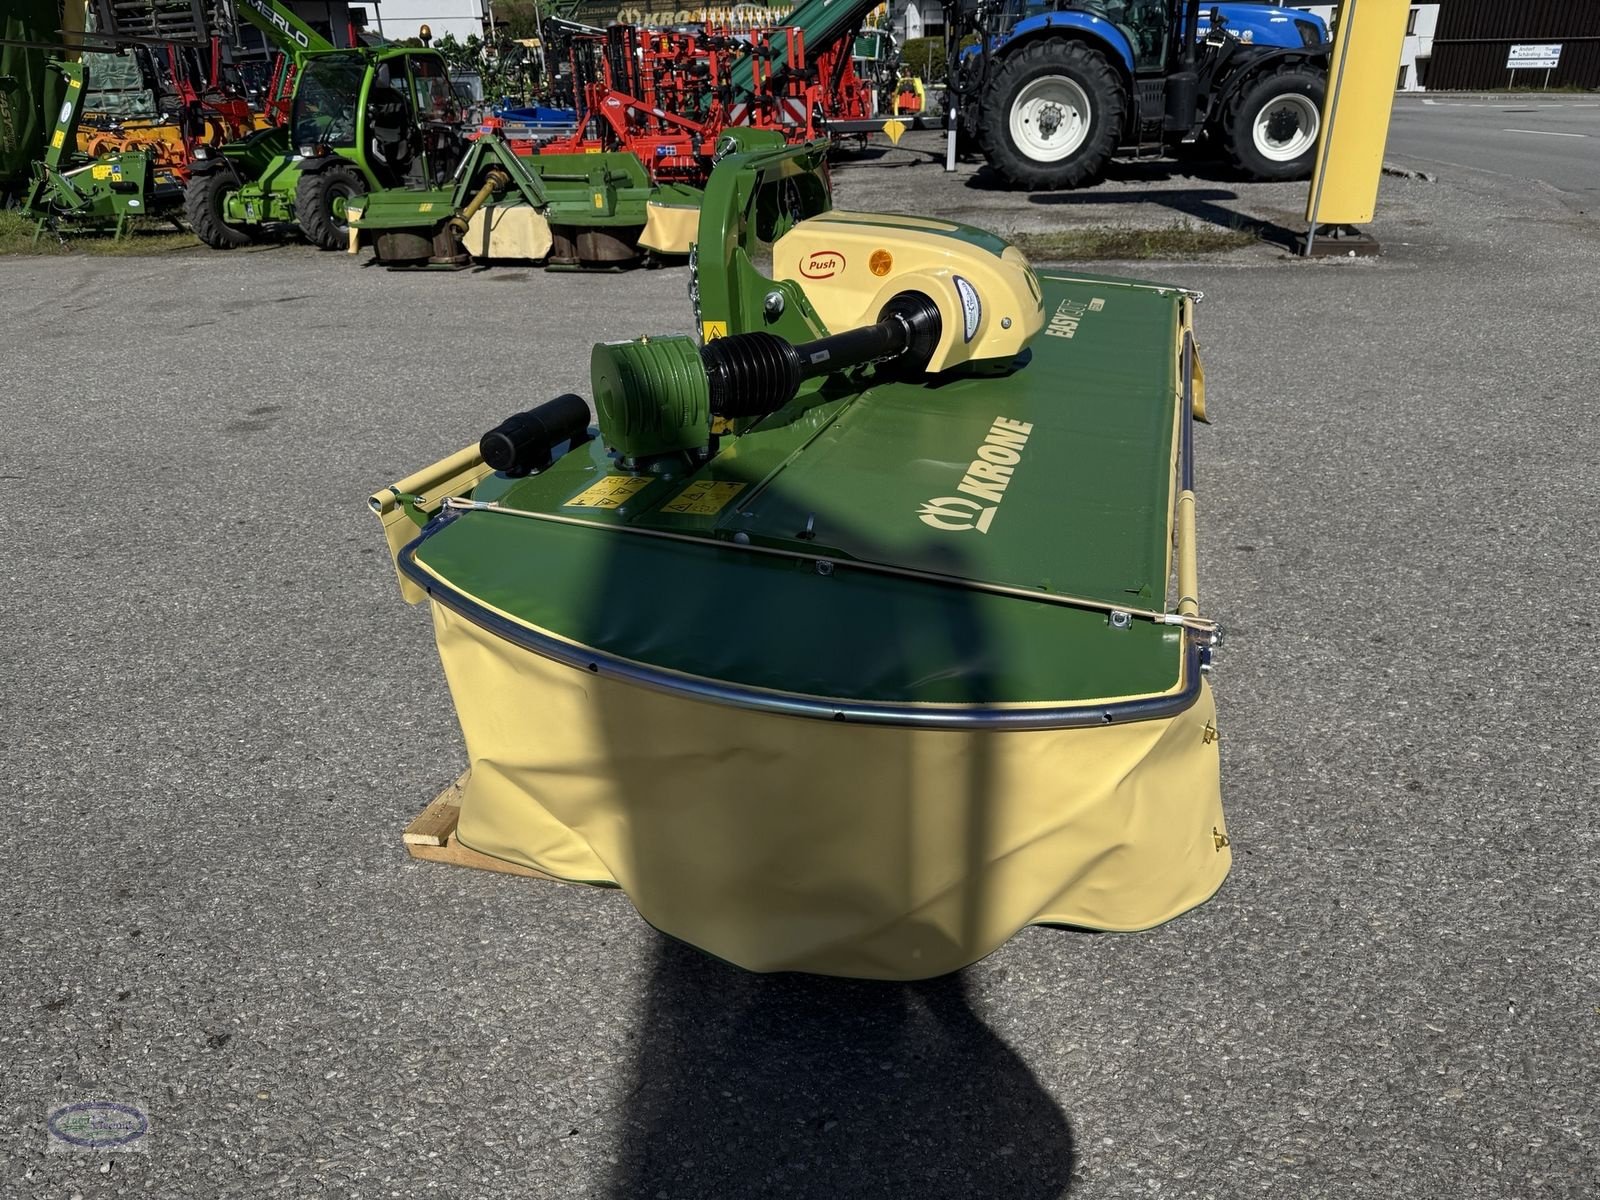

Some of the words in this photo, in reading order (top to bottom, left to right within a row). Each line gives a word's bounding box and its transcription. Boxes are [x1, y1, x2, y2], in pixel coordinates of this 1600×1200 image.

[247, 0, 309, 48] MERLO
[809, 259, 836, 270] Push
[957, 416, 1034, 504] KRONE
